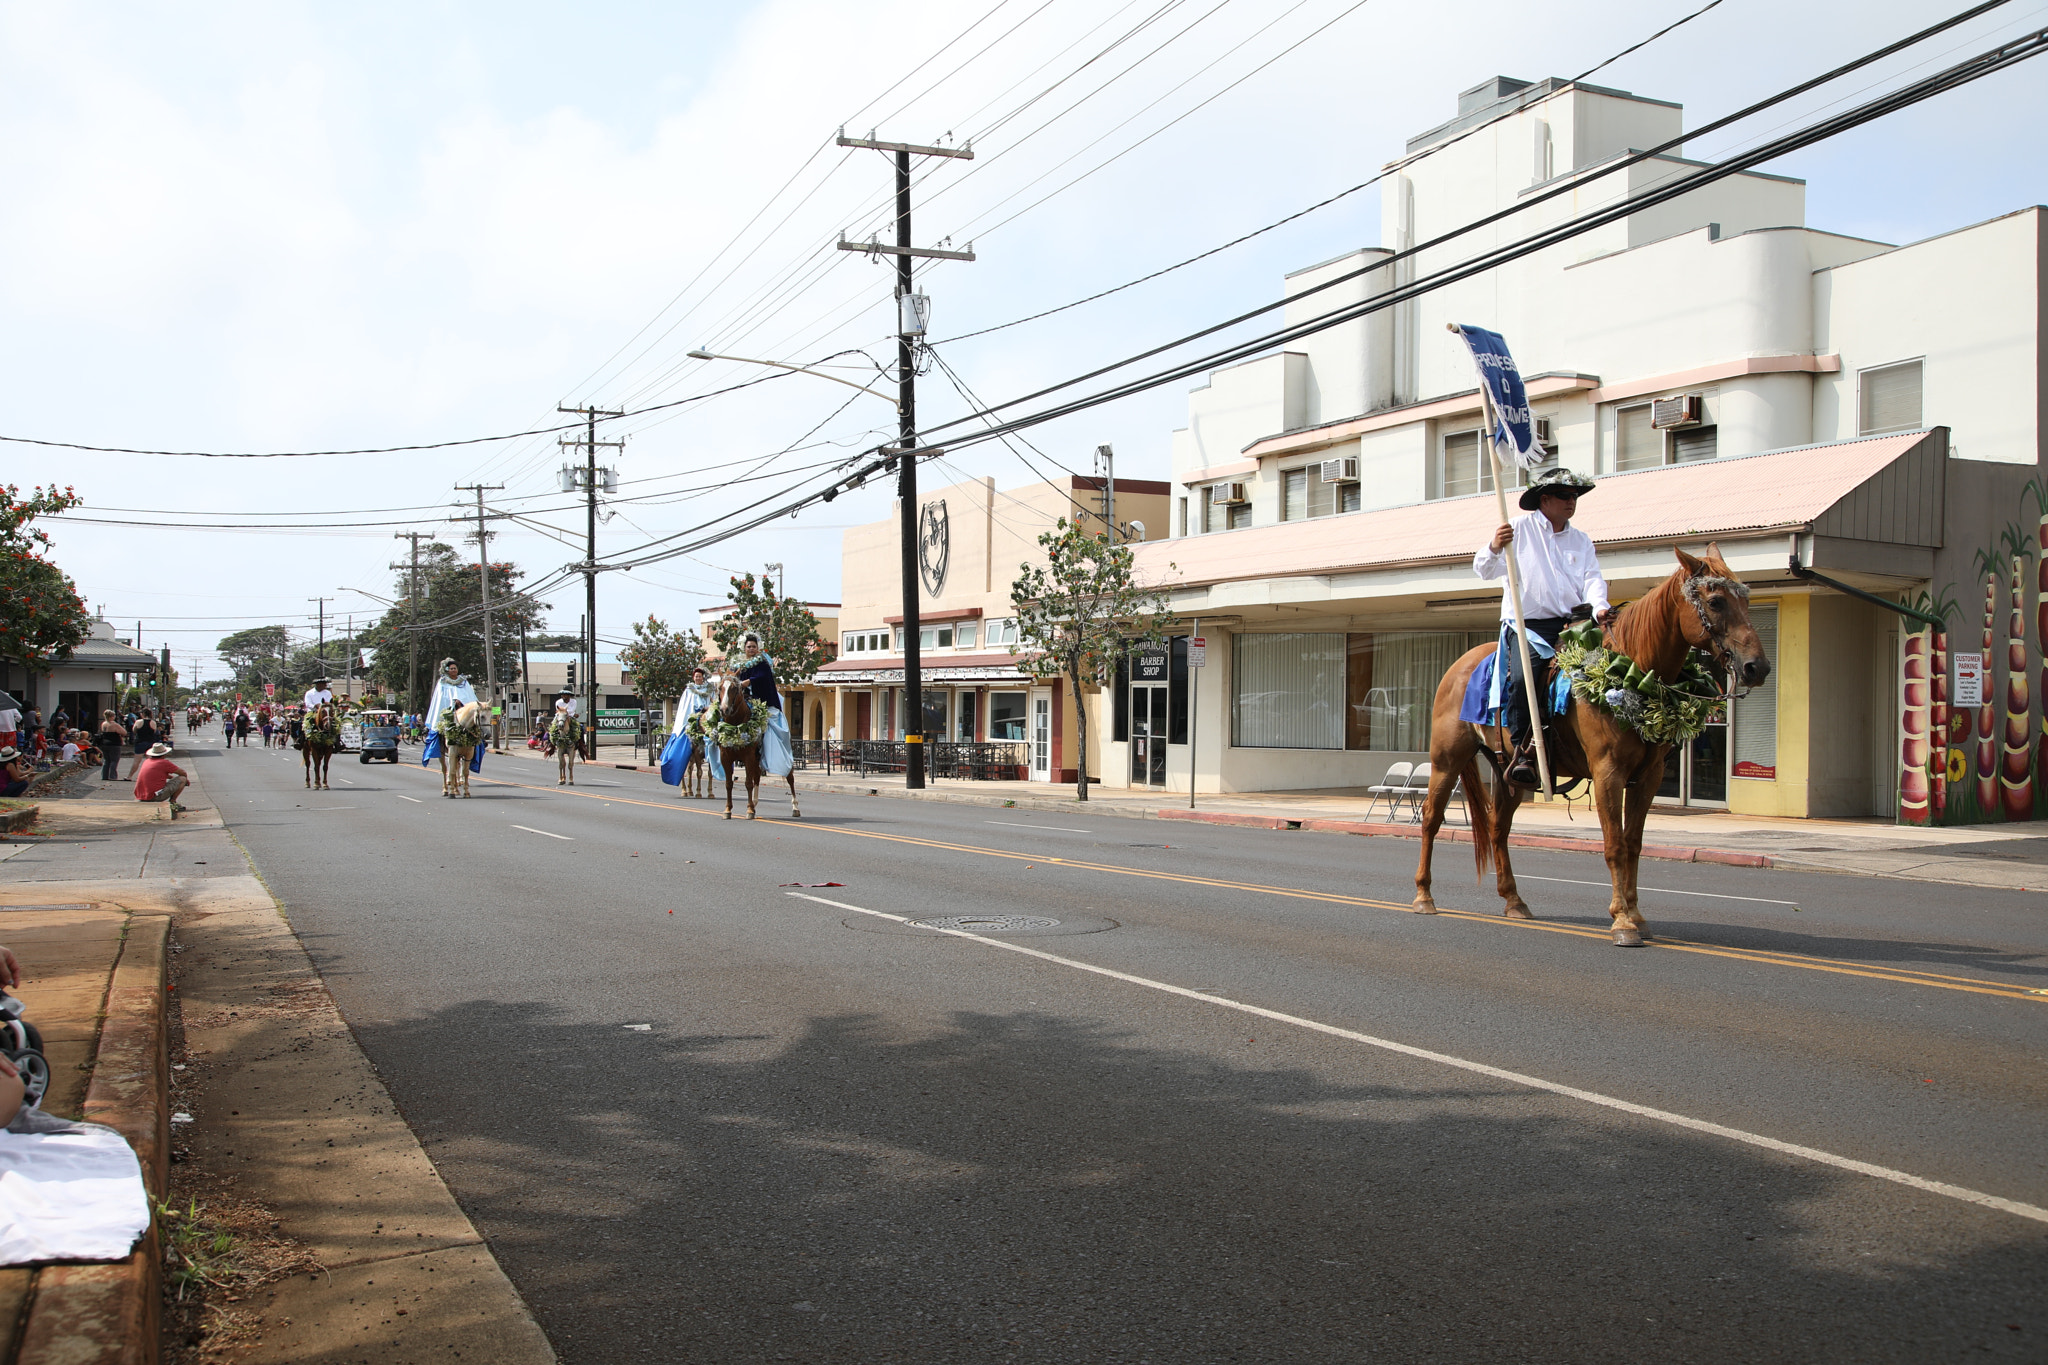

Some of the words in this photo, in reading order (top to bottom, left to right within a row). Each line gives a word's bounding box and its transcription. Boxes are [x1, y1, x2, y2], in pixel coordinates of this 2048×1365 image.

[1140, 656, 1165, 666] BARBER
[1142, 666, 1160, 676] SHOP
[598, 718, 634, 728] TOKIOKA
